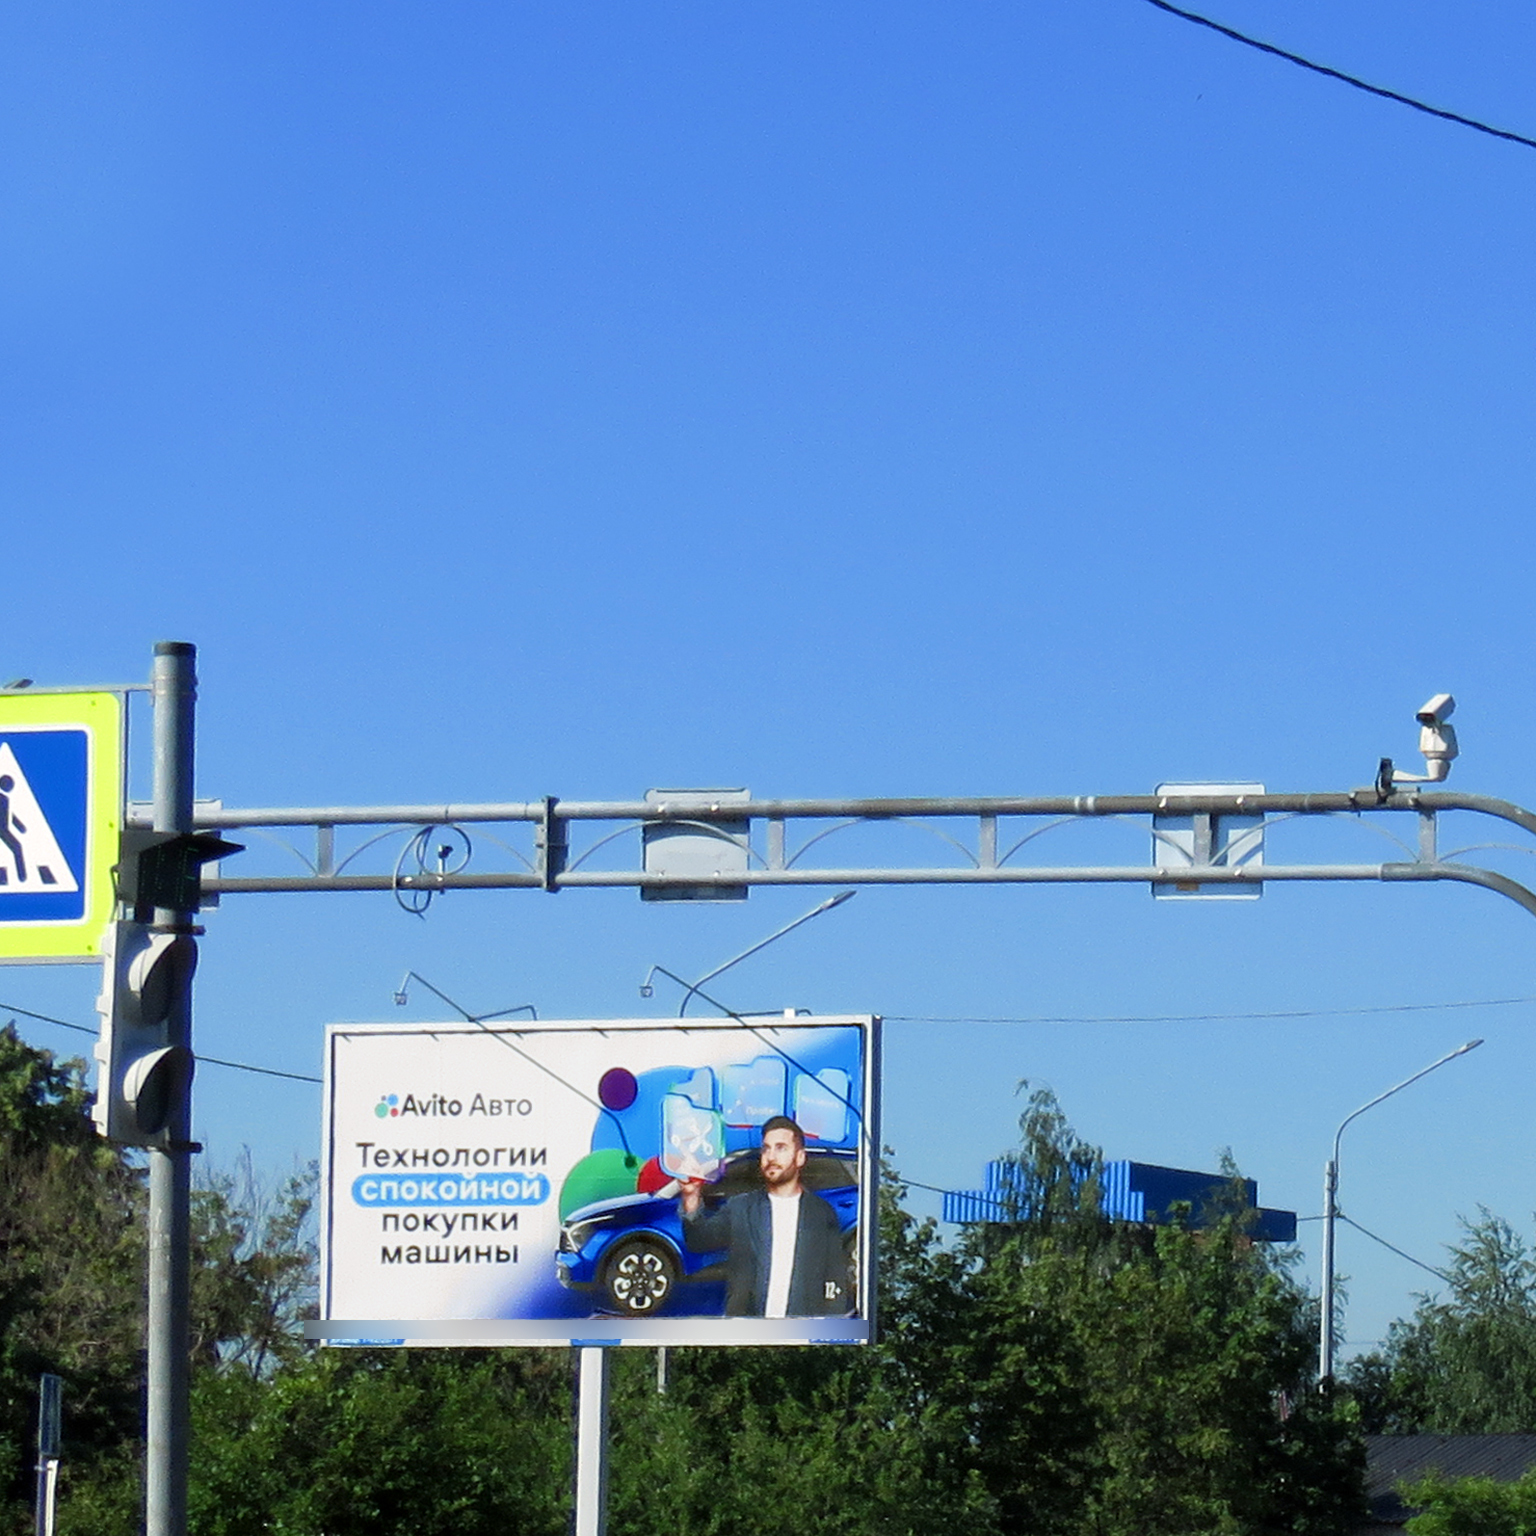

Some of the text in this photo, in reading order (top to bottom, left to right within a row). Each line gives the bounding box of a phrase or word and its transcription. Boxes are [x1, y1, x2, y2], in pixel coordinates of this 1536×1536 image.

[401, 1093, 533, 1117] Avito Авто
[355, 1142, 548, 1168] Технологии
[360, 1172, 542, 1201] спокойной
[382, 1212, 519, 1239] покупки
[381, 1245, 519, 1265] машины
